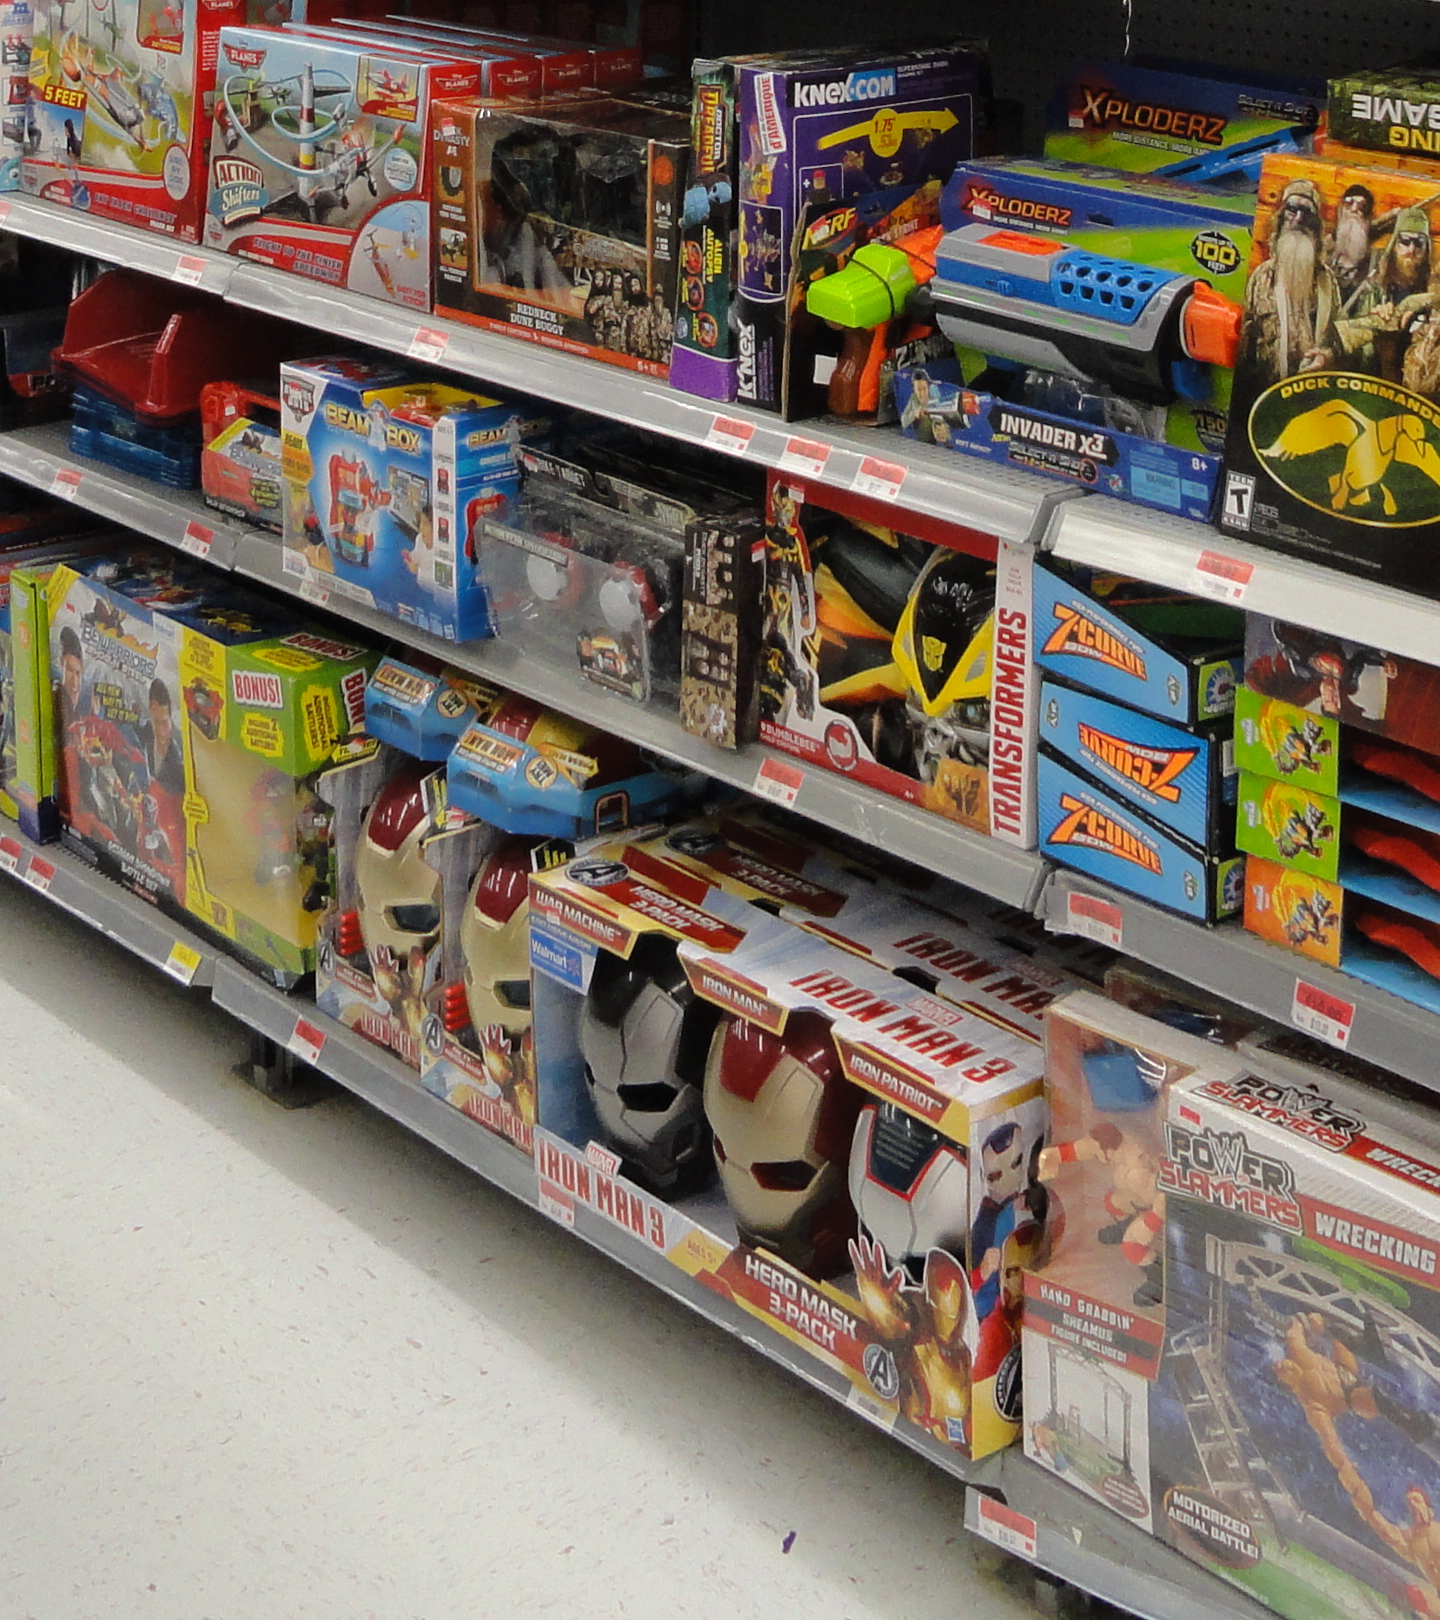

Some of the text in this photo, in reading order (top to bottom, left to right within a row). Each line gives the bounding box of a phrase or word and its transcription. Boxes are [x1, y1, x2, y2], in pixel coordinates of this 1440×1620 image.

[230, 51, 257, 64] PLANES
[44, 87, 84, 108] 5 FEET
[1080, 83, 1226, 144] XPLODERZ
[219, 159, 262, 185] ACTION
[222, 188, 260, 211] Shifters
[963, 183, 1072, 226] XPLODERZ
[1195, 241, 1236, 262] 100
[510, 312, 563, 337] DUNE BUGGY
[516, 302, 557, 323] REDNECK
[1280, 376, 1330, 399] DUCK
[325, 404, 420, 453] BEAM BOX
[468, 428, 506, 448] BEAM
[1000, 412, 1077, 449] INVADER
[1191, 458, 1208, 471] 8+
[286, 634, 358, 659] BONUS!
[234, 672, 280, 704] BONUS!
[992, 607, 1028, 837] TRANSFORMERS
[565, 905, 614, 942] MACHINE
[628, 883, 725, 932] HERO MASK
[628, 900, 692, 930] 3-PACK
[531, 939, 568, 969] Walmart
[702, 977, 762, 1016] IRON MAN
[790, 968, 1017, 1083] IRON MAN 3
[850, 1054, 934, 1112] IRON PATRIOT
[1204, 1080, 1350, 1152] SLAMMERS
[1232, 1073, 1365, 1139] POWER
[587, 1146, 616, 1176] MARVEL
[1168, 1130, 1294, 1194] POWER
[539, 1138, 665, 1249] IRON MAN 3
[1159, 1160, 1302, 1230] SLAMMERS
[1314, 1210, 1436, 1275] WRECKING
[745, 1255, 857, 1340] HERO MASK
[1040, 1284, 1135, 1330] HAND GRABBIN'
[769, 1293, 835, 1351] 3-PACK
[1062, 1312, 1113, 1343] SHEAMUS
[1051, 1324, 1127, 1364] FIGURE INCLUDED!
[1168, 1505, 1258, 1560] AERIAL BATTLE!
[1173, 1490, 1250, 1539] MOTORIZED
